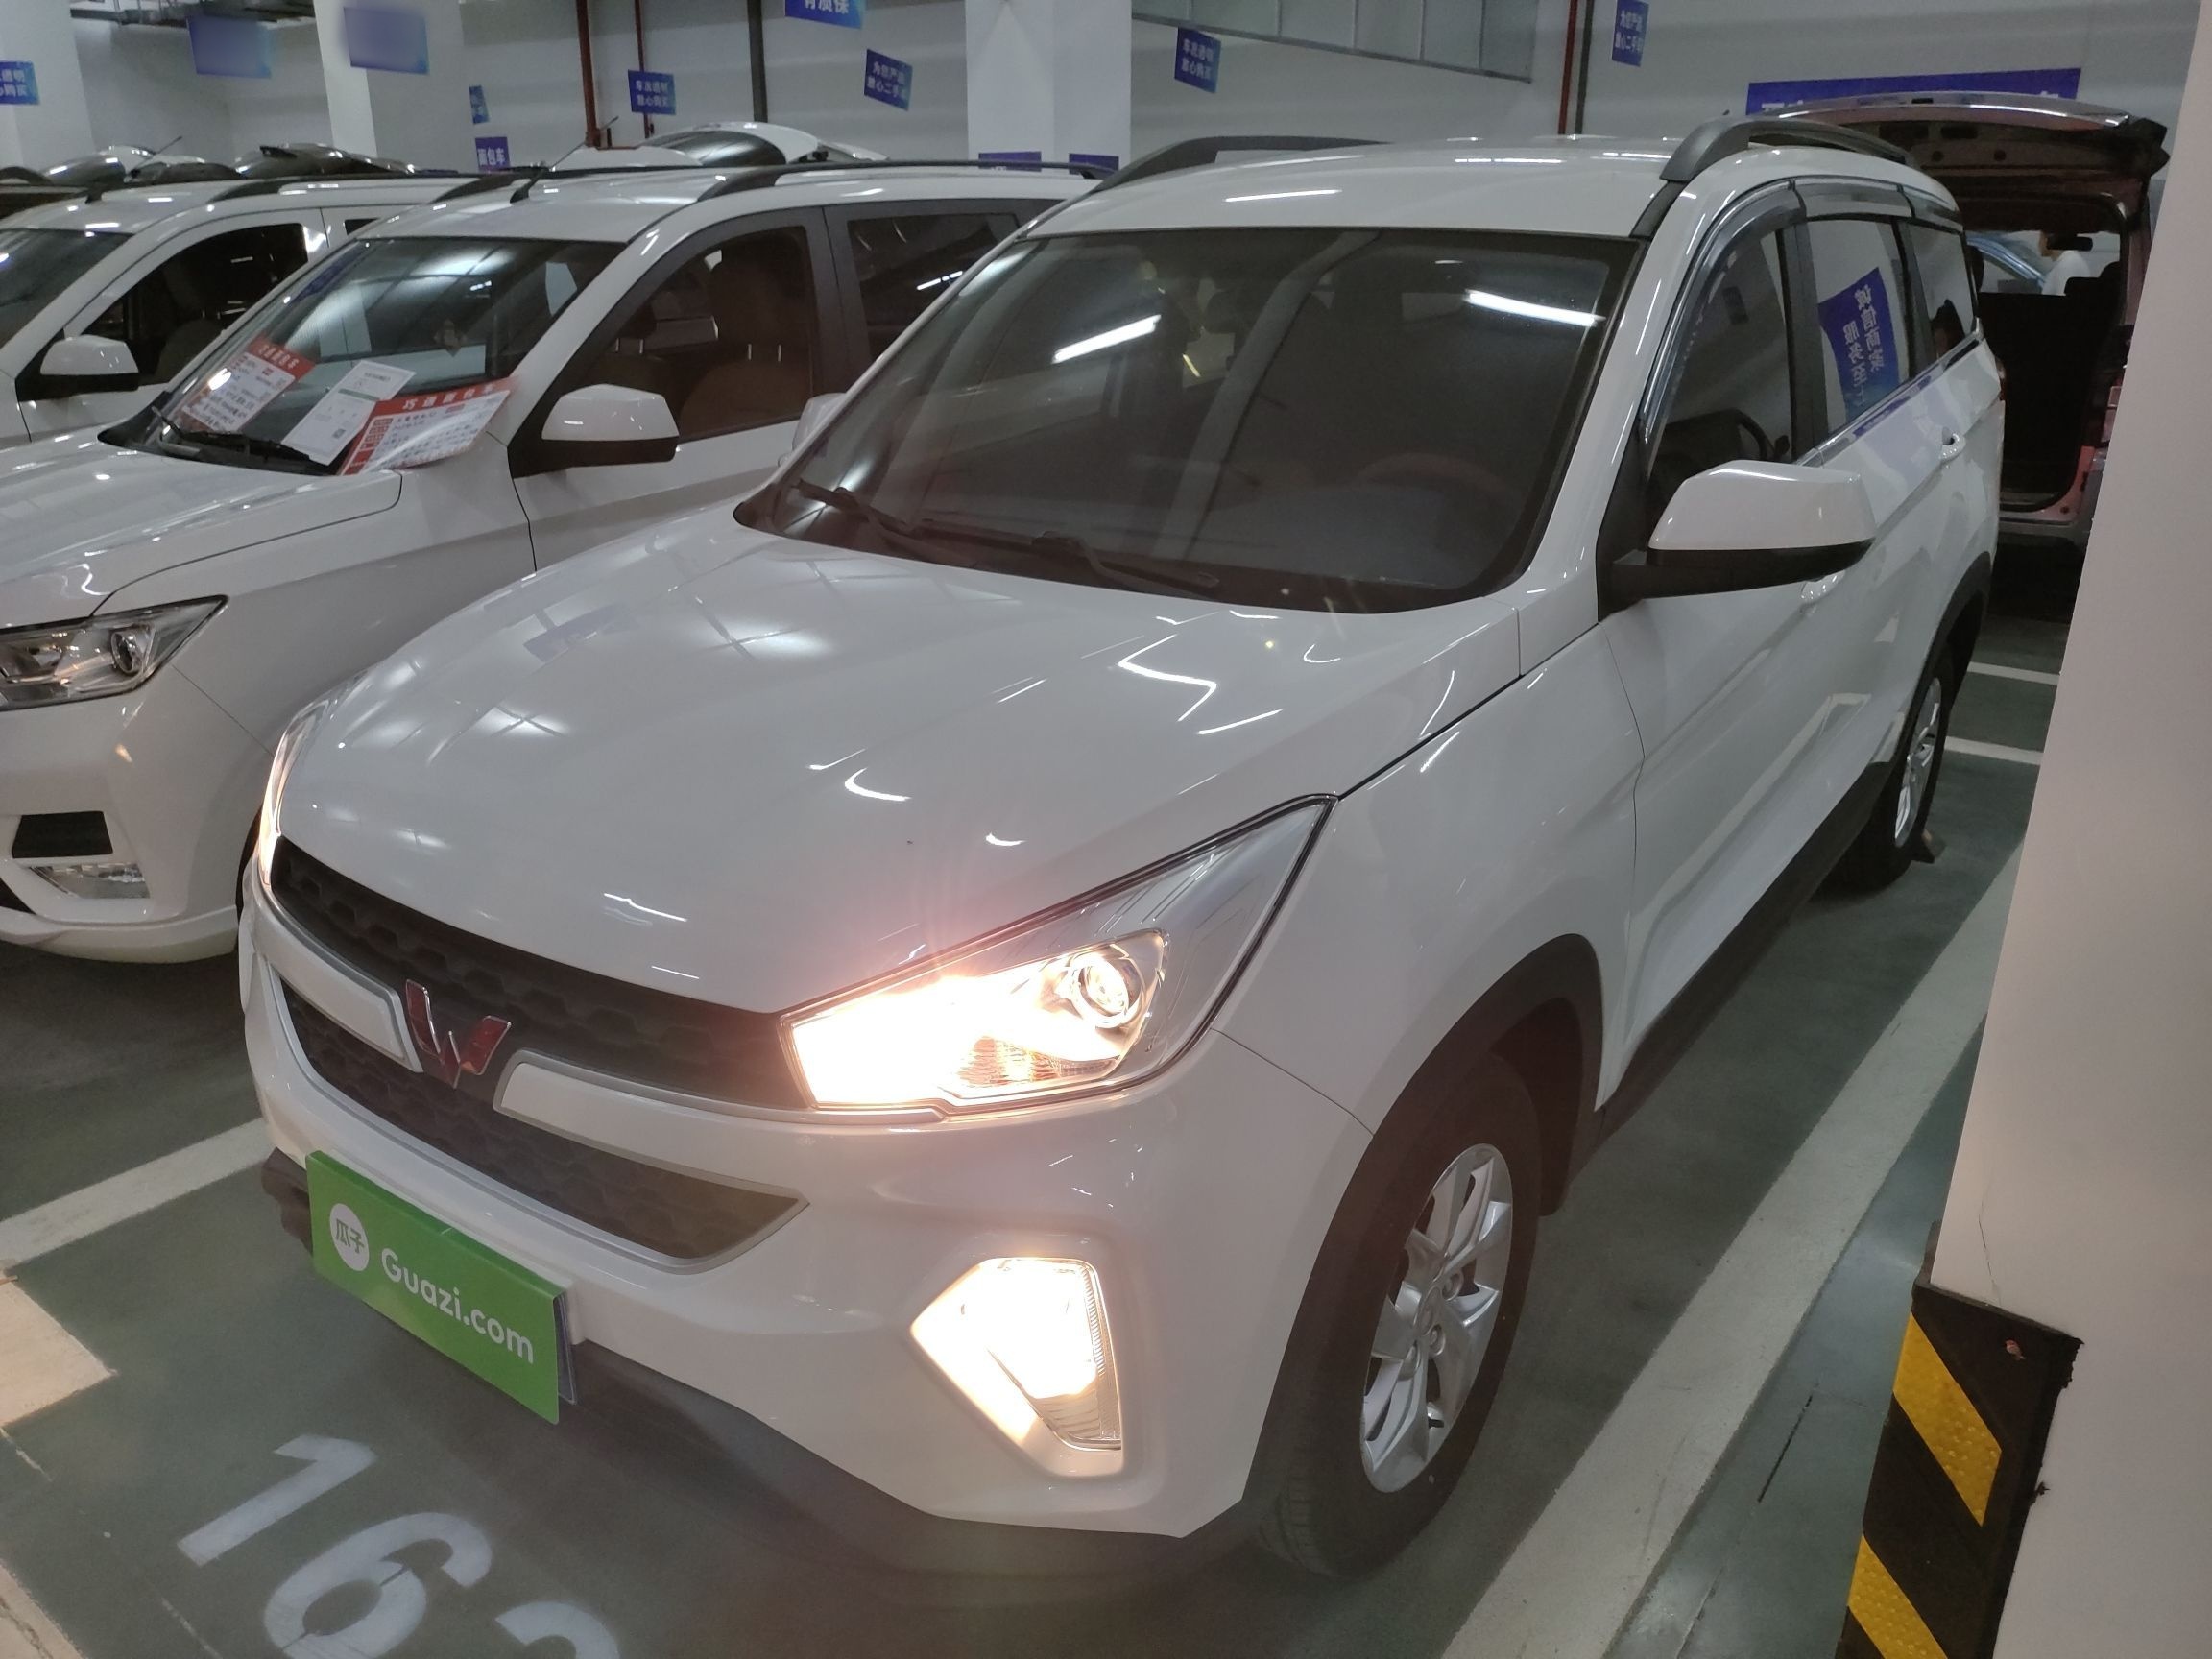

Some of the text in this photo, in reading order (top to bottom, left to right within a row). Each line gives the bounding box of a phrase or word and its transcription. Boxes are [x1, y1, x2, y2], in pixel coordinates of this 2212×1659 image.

[0, 68, 25, 84] 透明
[335, 1218, 365, 1254] 瓜子
[381, 1247, 535, 1365] Guazi.com
